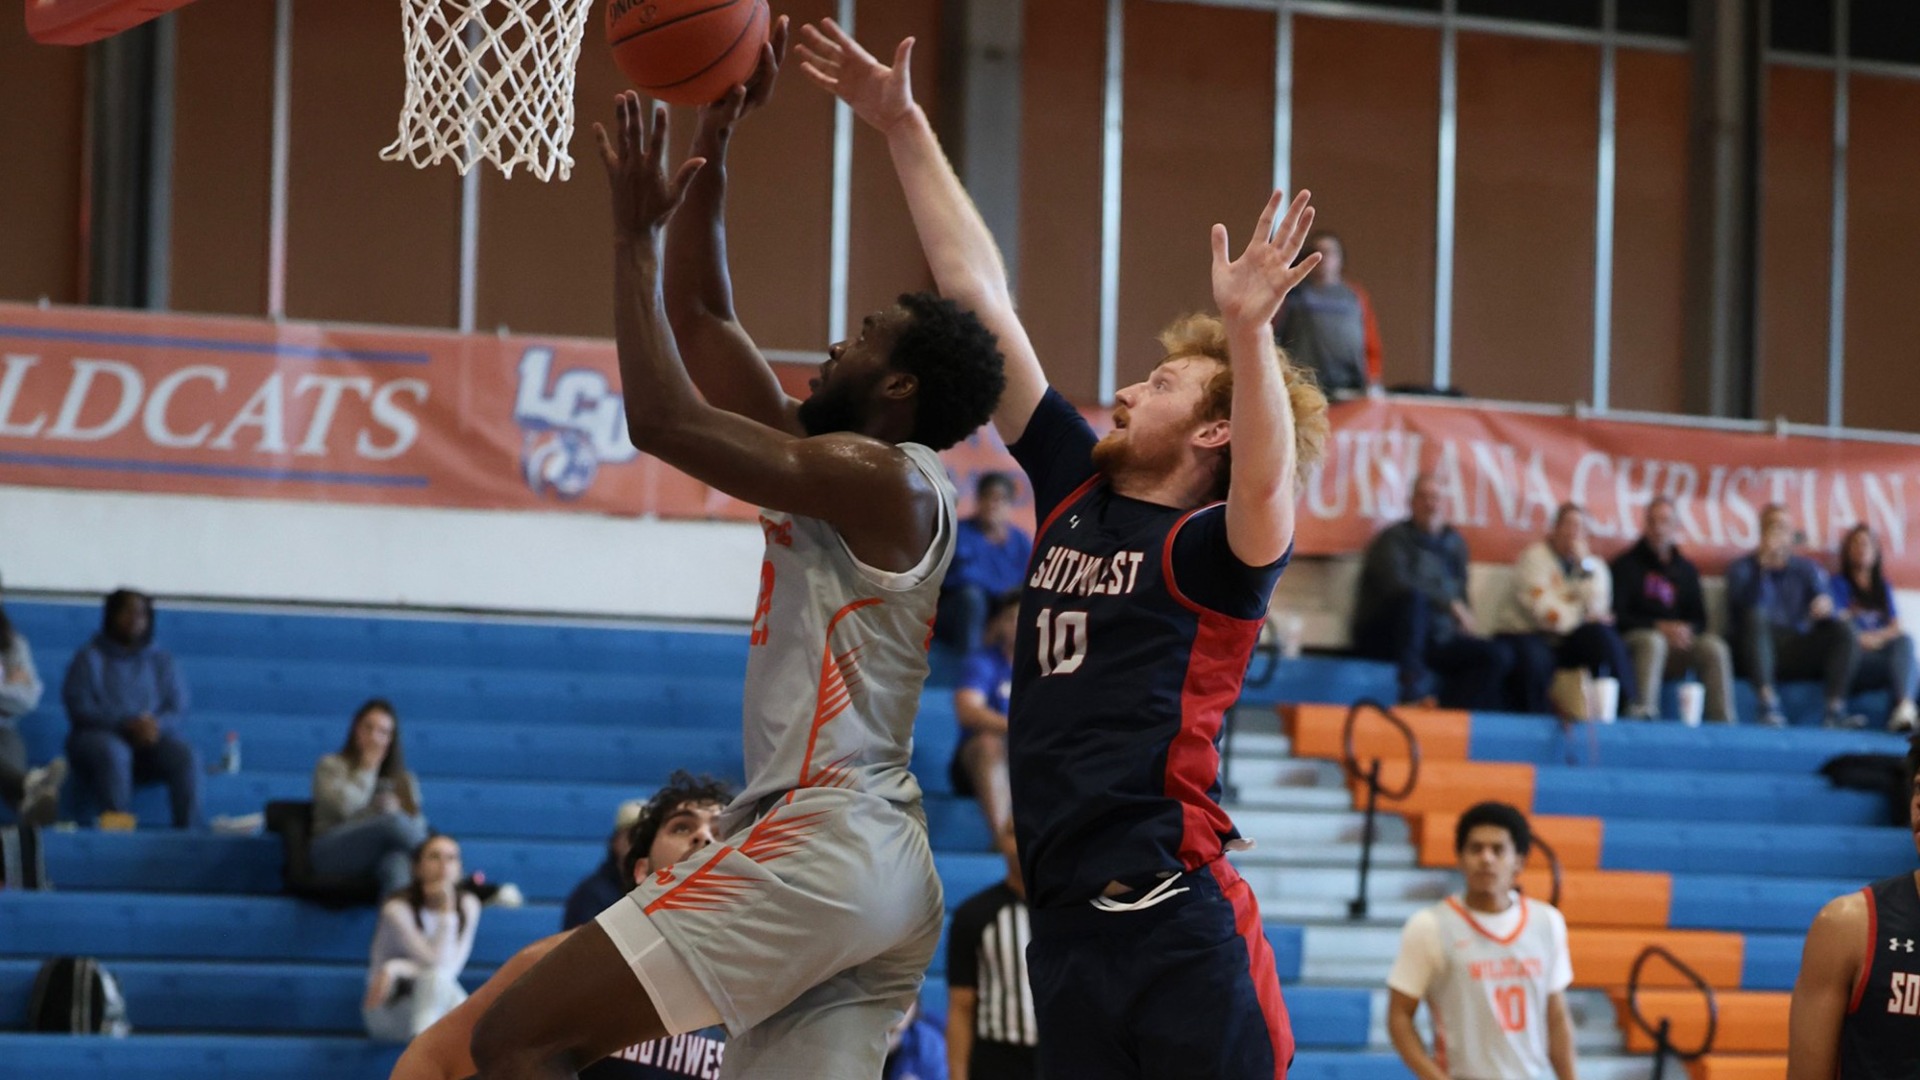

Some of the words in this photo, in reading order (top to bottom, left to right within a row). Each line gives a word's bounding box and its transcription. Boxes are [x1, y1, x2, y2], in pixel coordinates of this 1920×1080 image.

[1297, 429, 1559, 531] UISIANA
[1036, 608, 1088, 677] 10
[1495, 985, 1526, 1032] 10
